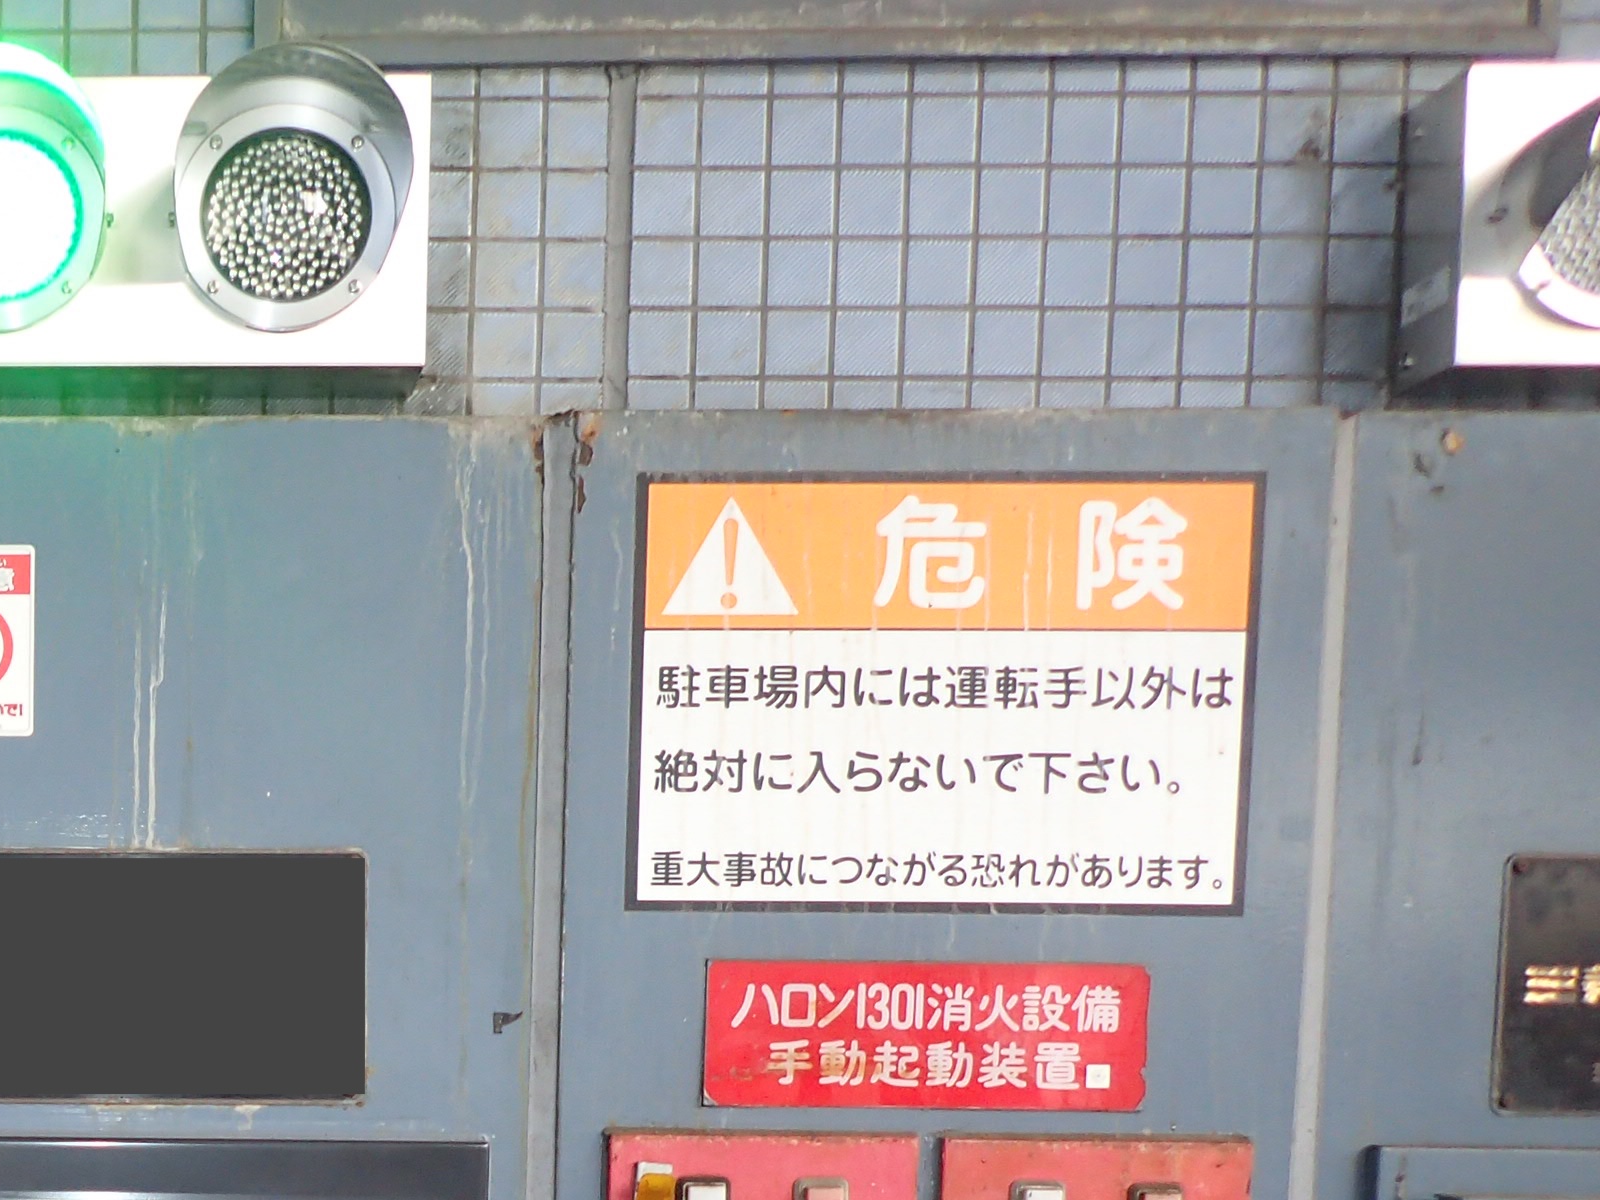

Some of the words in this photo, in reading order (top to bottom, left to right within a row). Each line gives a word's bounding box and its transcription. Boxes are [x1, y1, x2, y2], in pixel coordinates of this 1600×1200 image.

[872, 494, 1188, 610] 危険
[655, 663, 1234, 711] 駐車場内には運転手以外は
[653, 748, 1181, 795] 絶対に入らないで下さい。
[649, 849, 1224, 890] 重大事故につながる恐れがあります。
[730, 982, 1120, 1033] ハロン1301消火設備
[766, 1039, 1082, 1089] 手動起動装置
